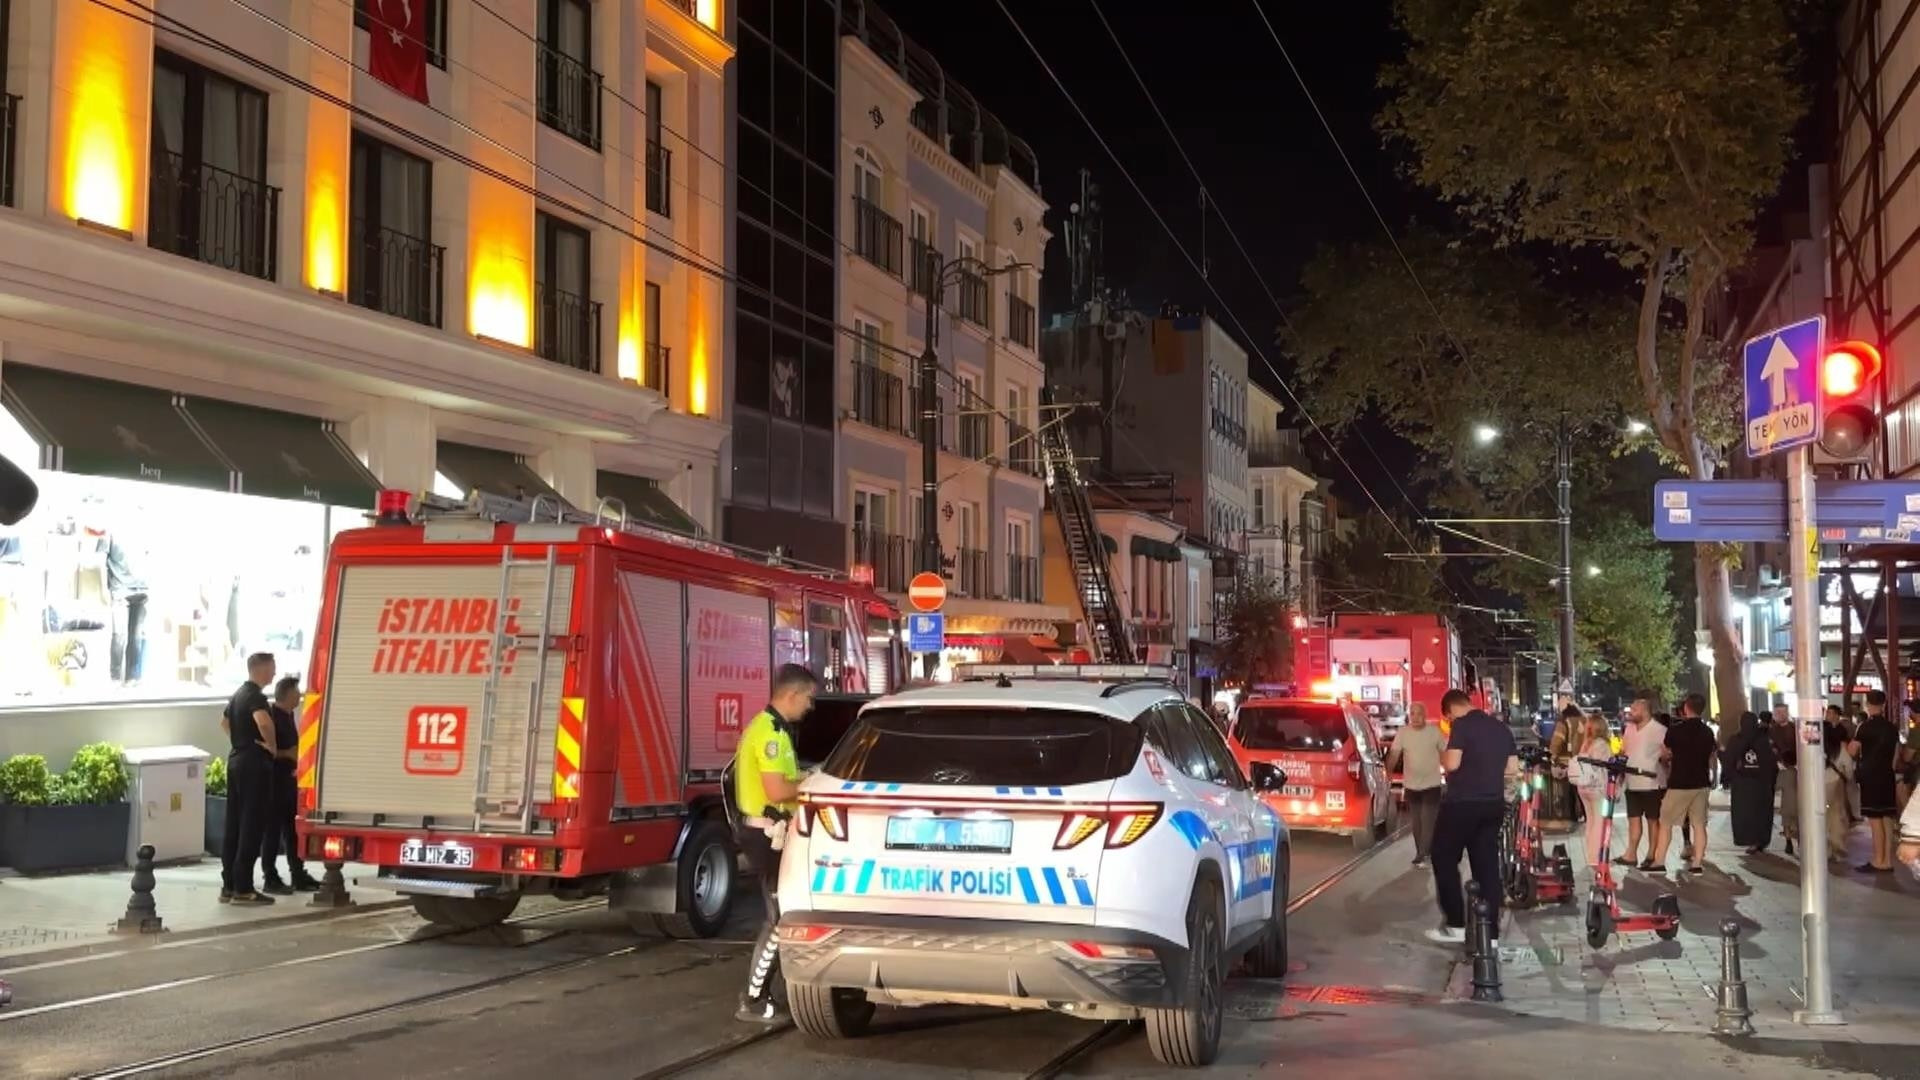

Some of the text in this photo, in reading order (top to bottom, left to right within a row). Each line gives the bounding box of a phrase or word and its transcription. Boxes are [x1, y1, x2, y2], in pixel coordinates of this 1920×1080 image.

[1783, 410, 1809, 431] YÖN
[373, 638, 517, 674] İTFAİYEİ
[417, 713, 458, 745] 112
[719, 699, 740, 727] 112
[881, 864, 1012, 896] TRAFİK POLİSİ
